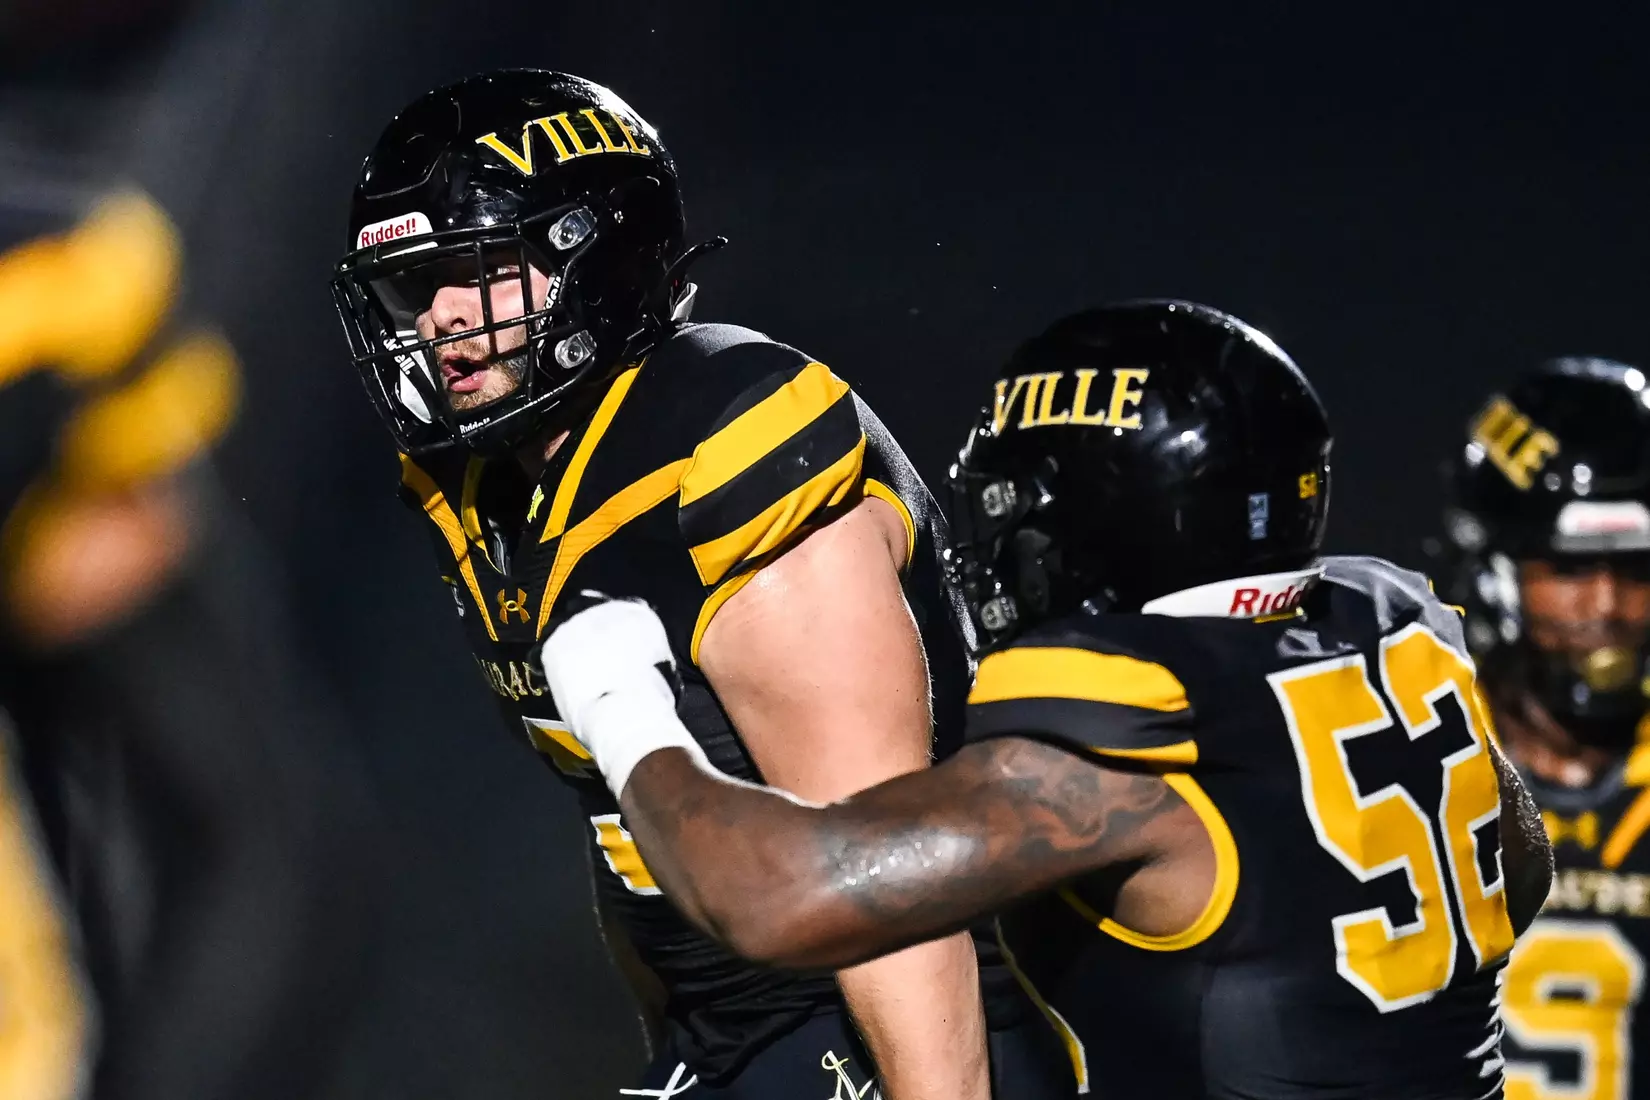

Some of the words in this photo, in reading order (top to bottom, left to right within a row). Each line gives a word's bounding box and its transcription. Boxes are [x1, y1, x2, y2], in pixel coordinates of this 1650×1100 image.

[475, 109, 651, 176] VILLE
[993, 368, 1149, 437] VILLE
[1266, 622, 1515, 1013] 52
